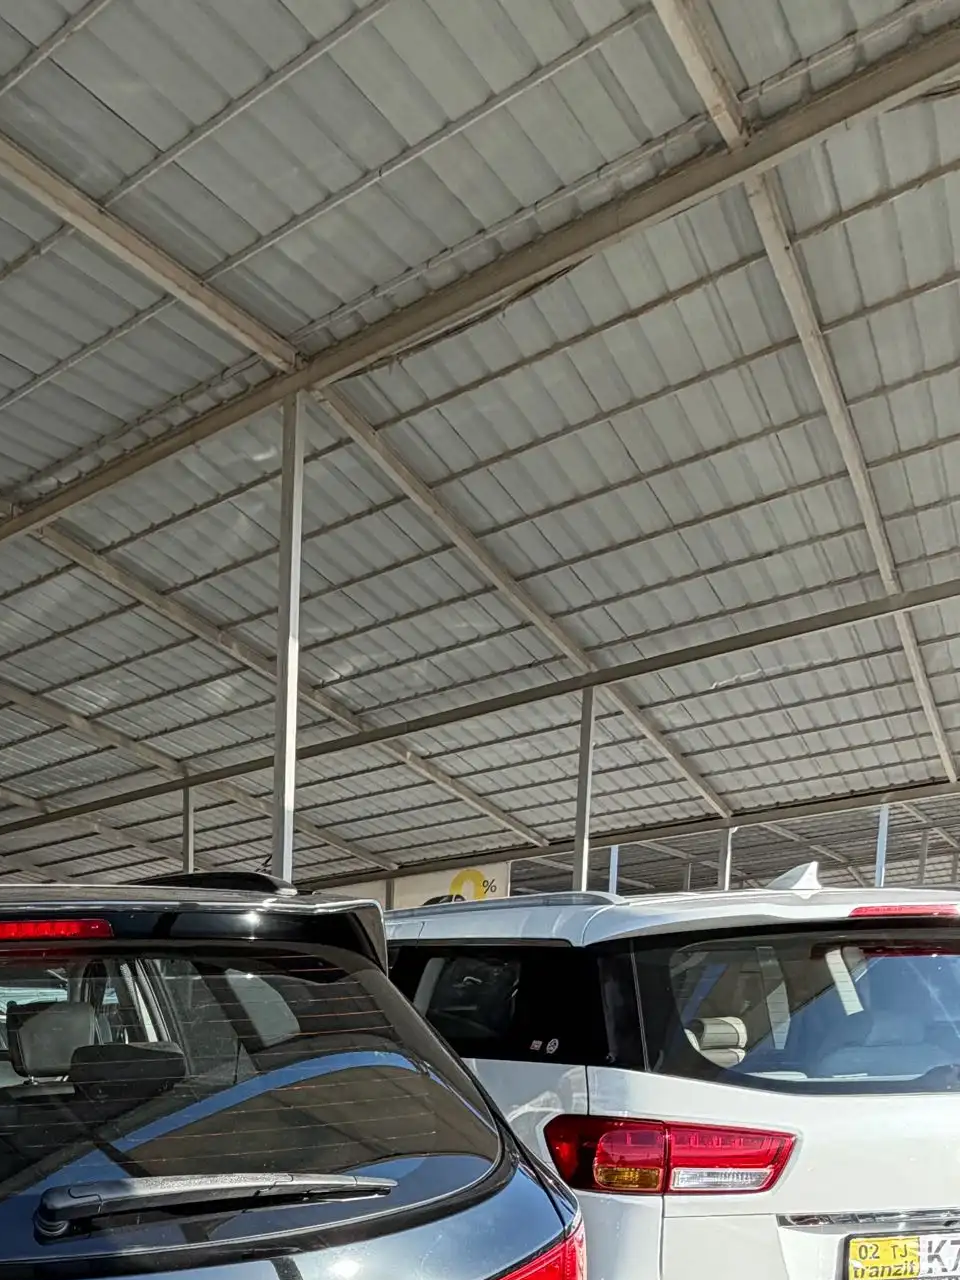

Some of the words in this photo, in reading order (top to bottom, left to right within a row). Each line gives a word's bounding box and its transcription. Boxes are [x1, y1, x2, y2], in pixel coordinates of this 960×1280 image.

[858, 1243, 881, 1260] 02
[890, 1243, 909, 1259] TJ
[852, 1260, 917, 1279] tranzit
